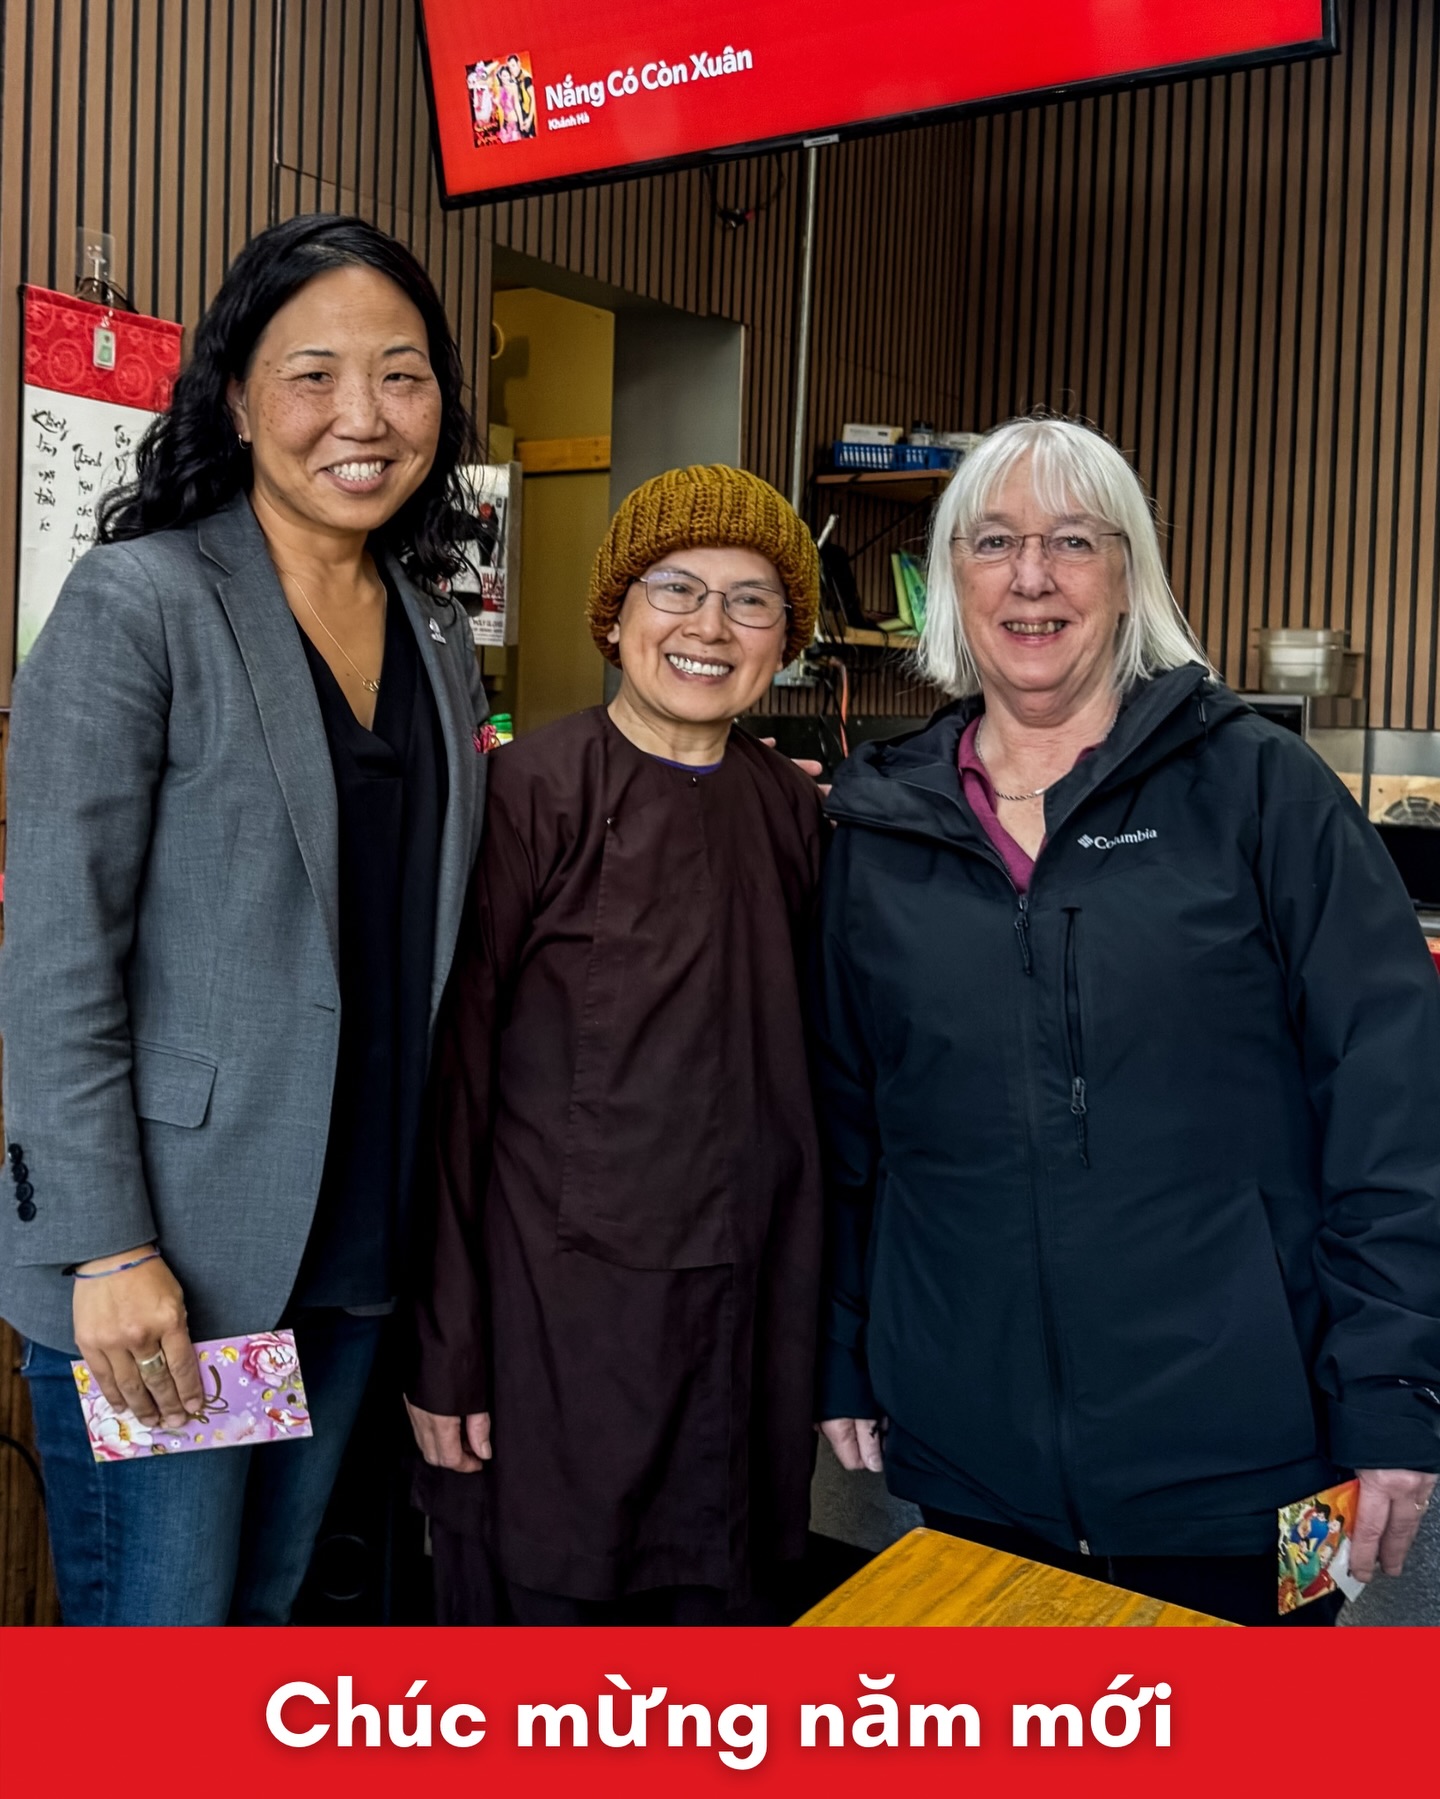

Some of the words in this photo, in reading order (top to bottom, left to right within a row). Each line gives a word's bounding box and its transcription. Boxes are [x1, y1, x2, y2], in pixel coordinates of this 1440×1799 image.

[545, 73, 606, 111] Nắng
[607, 66, 639, 97] Có
[641, 59, 688, 90] Còn
[690, 46, 753, 81] Xuân
[1094, 828, 1158, 850] Coumbia
